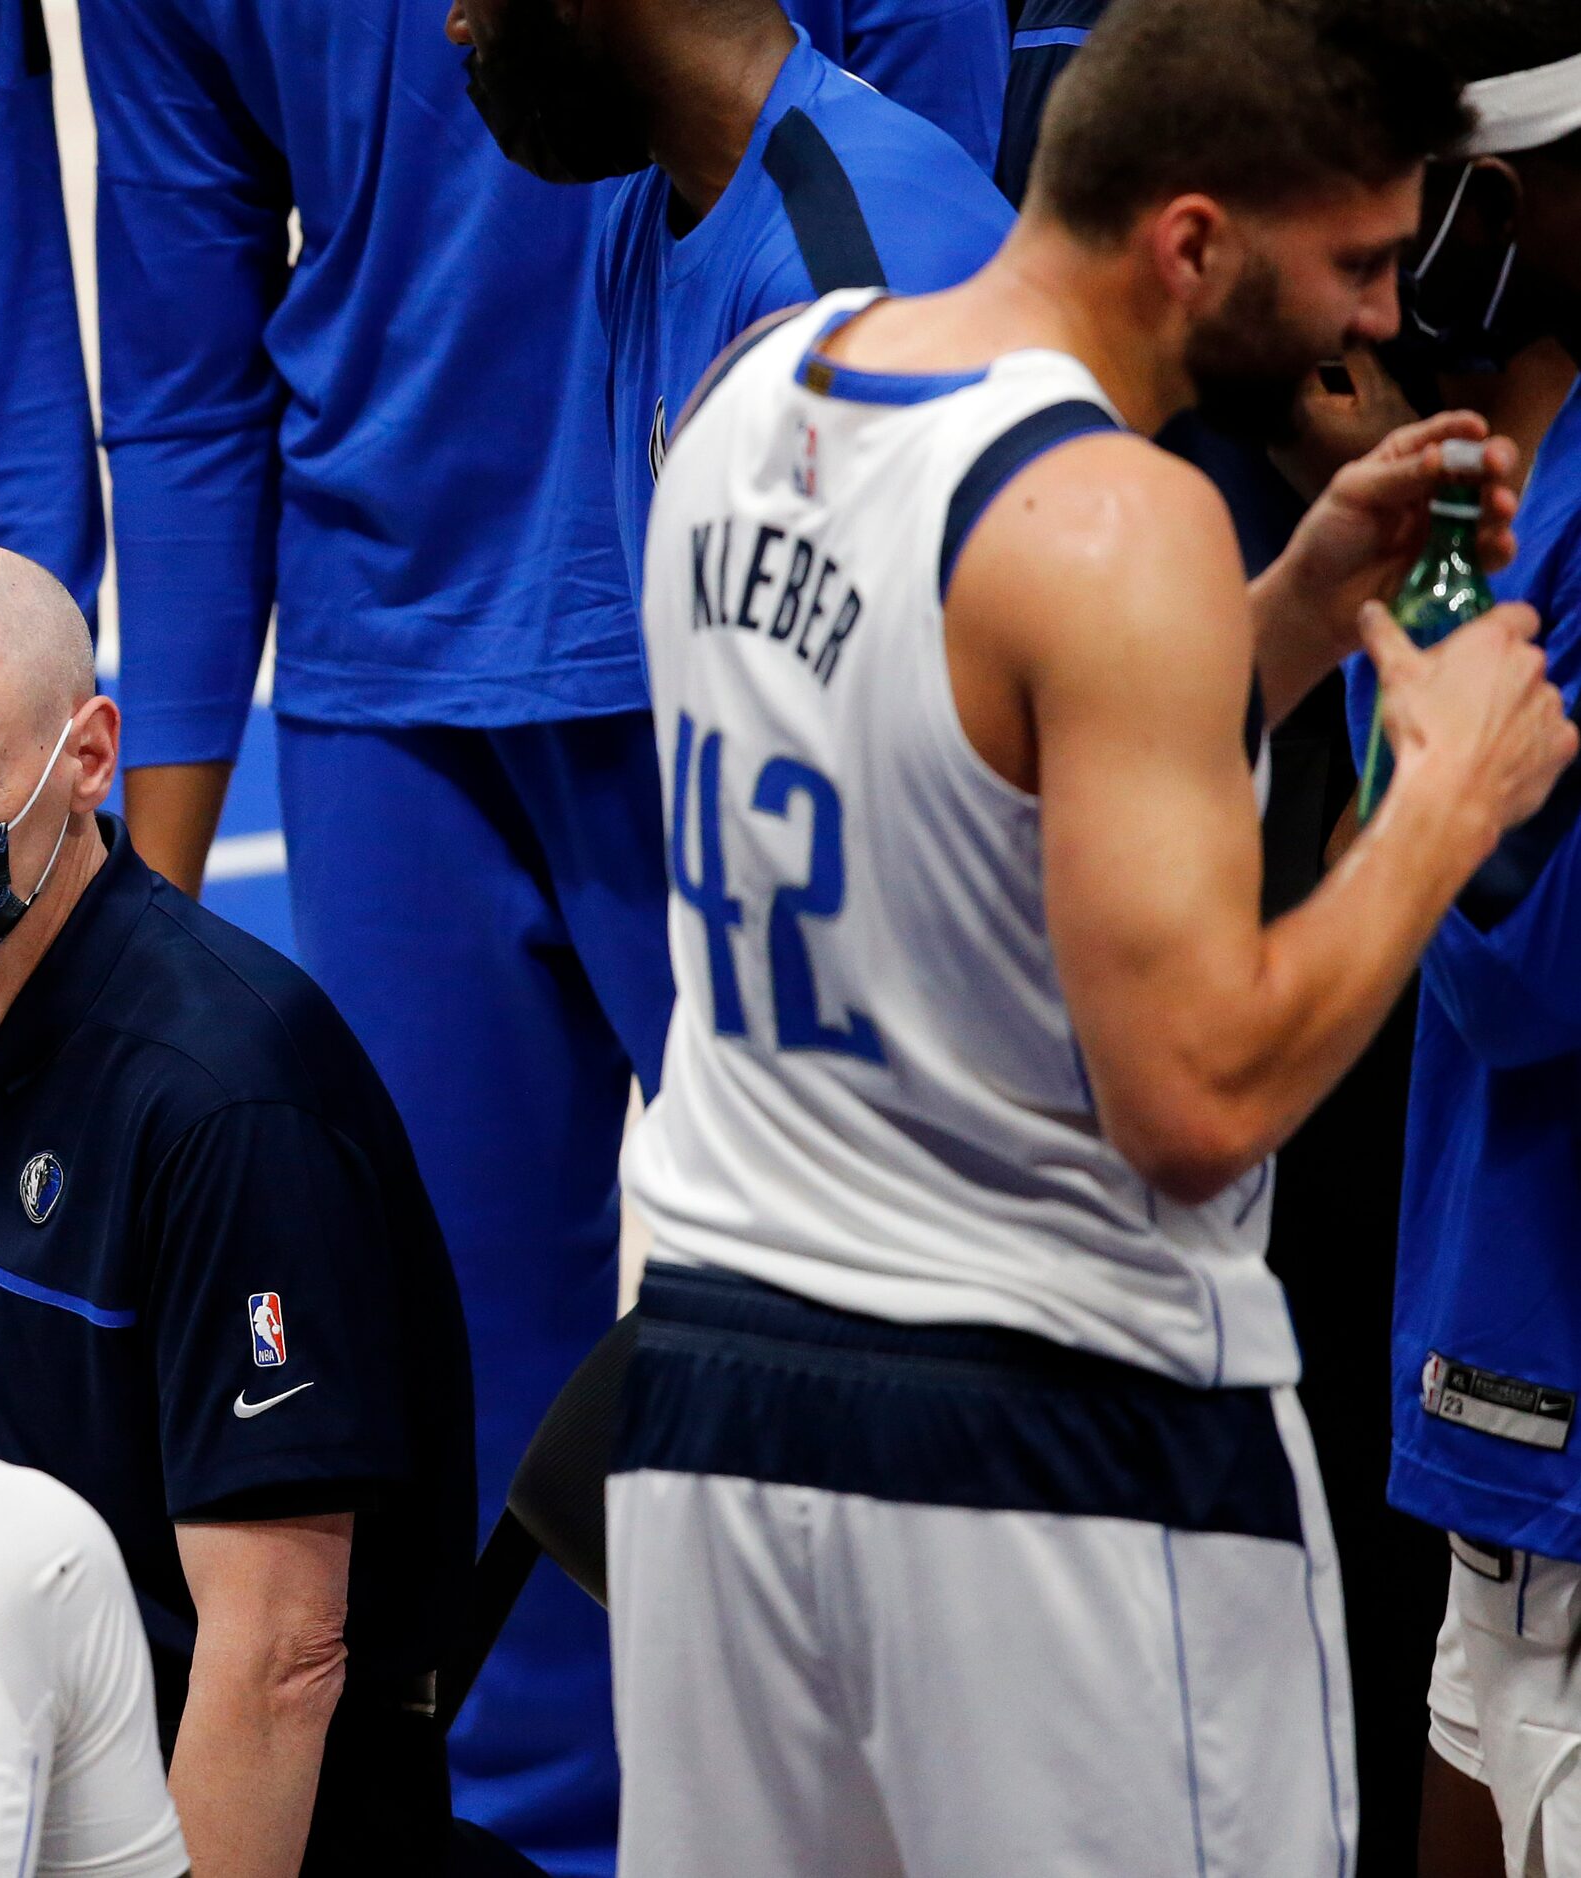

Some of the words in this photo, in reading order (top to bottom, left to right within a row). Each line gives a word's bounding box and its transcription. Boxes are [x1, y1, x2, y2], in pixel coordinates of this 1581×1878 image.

[691, 517, 863, 688] KLEBER
[671, 710, 887, 1066] 42
[258, 1349, 275, 1362] NBA
